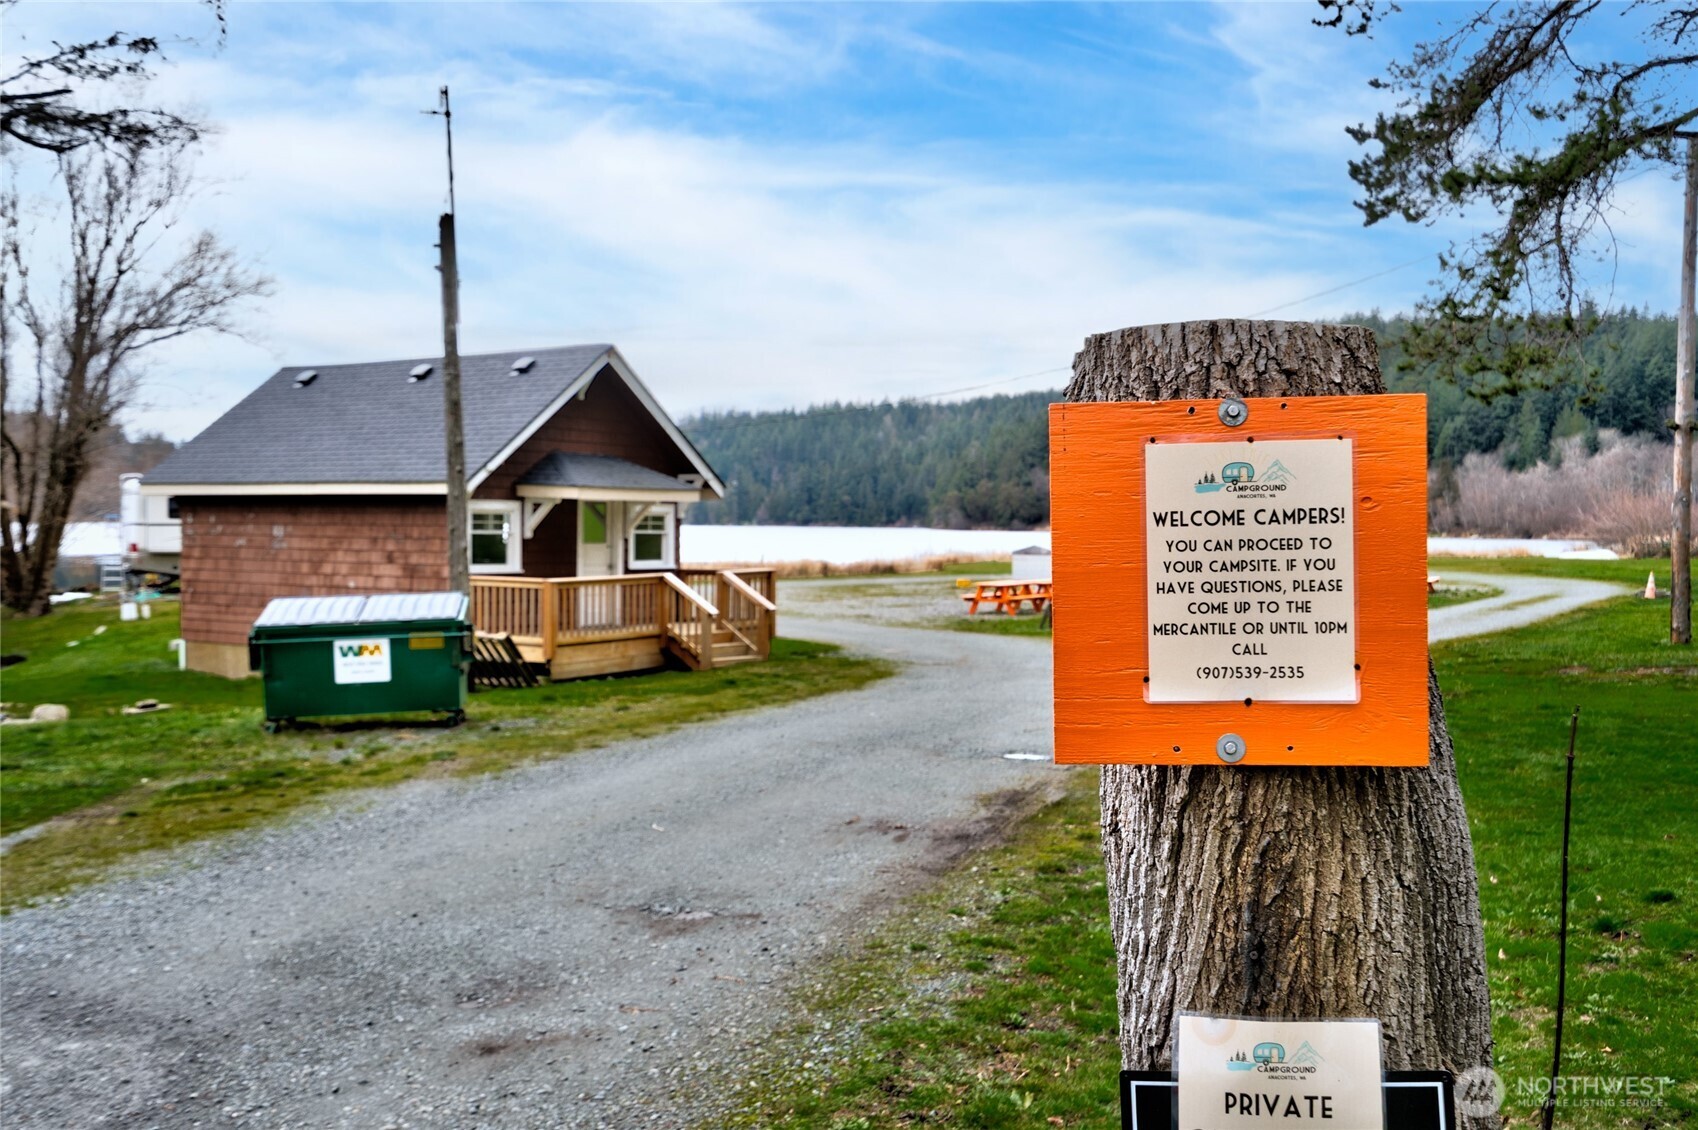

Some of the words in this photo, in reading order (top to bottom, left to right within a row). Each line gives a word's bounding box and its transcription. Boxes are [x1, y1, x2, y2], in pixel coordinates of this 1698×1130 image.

[1226, 484, 1287, 492] CAMPGROUND
[1153, 509, 1245, 527] WELCOME
[1254, 507, 1345, 525] CAMPERS!
[1166, 540, 1197, 552] YOU
[1203, 539, 1233, 551] CAN
[1239, 538, 1303, 551] PROCEED
[1310, 537, 1332, 549] TO
[1163, 561, 1203, 573] YOUR
[1209, 559, 1280, 572] CAMPSITE.
[1286, 559, 1297, 571] IF
[1304, 558, 1335, 571] YOU
[1156, 581, 1195, 594] HAVE
[1201, 580, 1287, 595] QUESTIONS,
[1293, 580, 1343, 592] PLEASE
[1187, 602, 1228, 614] COME
[1234, 602, 1251, 614] UP
[1257, 601, 1279, 613] TO
[1286, 601, 1312, 612] THE
[1153, 623, 1236, 636] MERCANTILE
[1242, 622, 1264, 635] OR
[1270, 622, 1308, 634] UNTIL
[1315, 622, 1347, 634] 10PM
[1232, 643, 1267, 655] CALL
[1196, 666, 1304, 679] (907)539-2535
[1257, 1065, 1316, 1073] CAMPGROUND
[1225, 1092, 1333, 1119] PRIVATE
